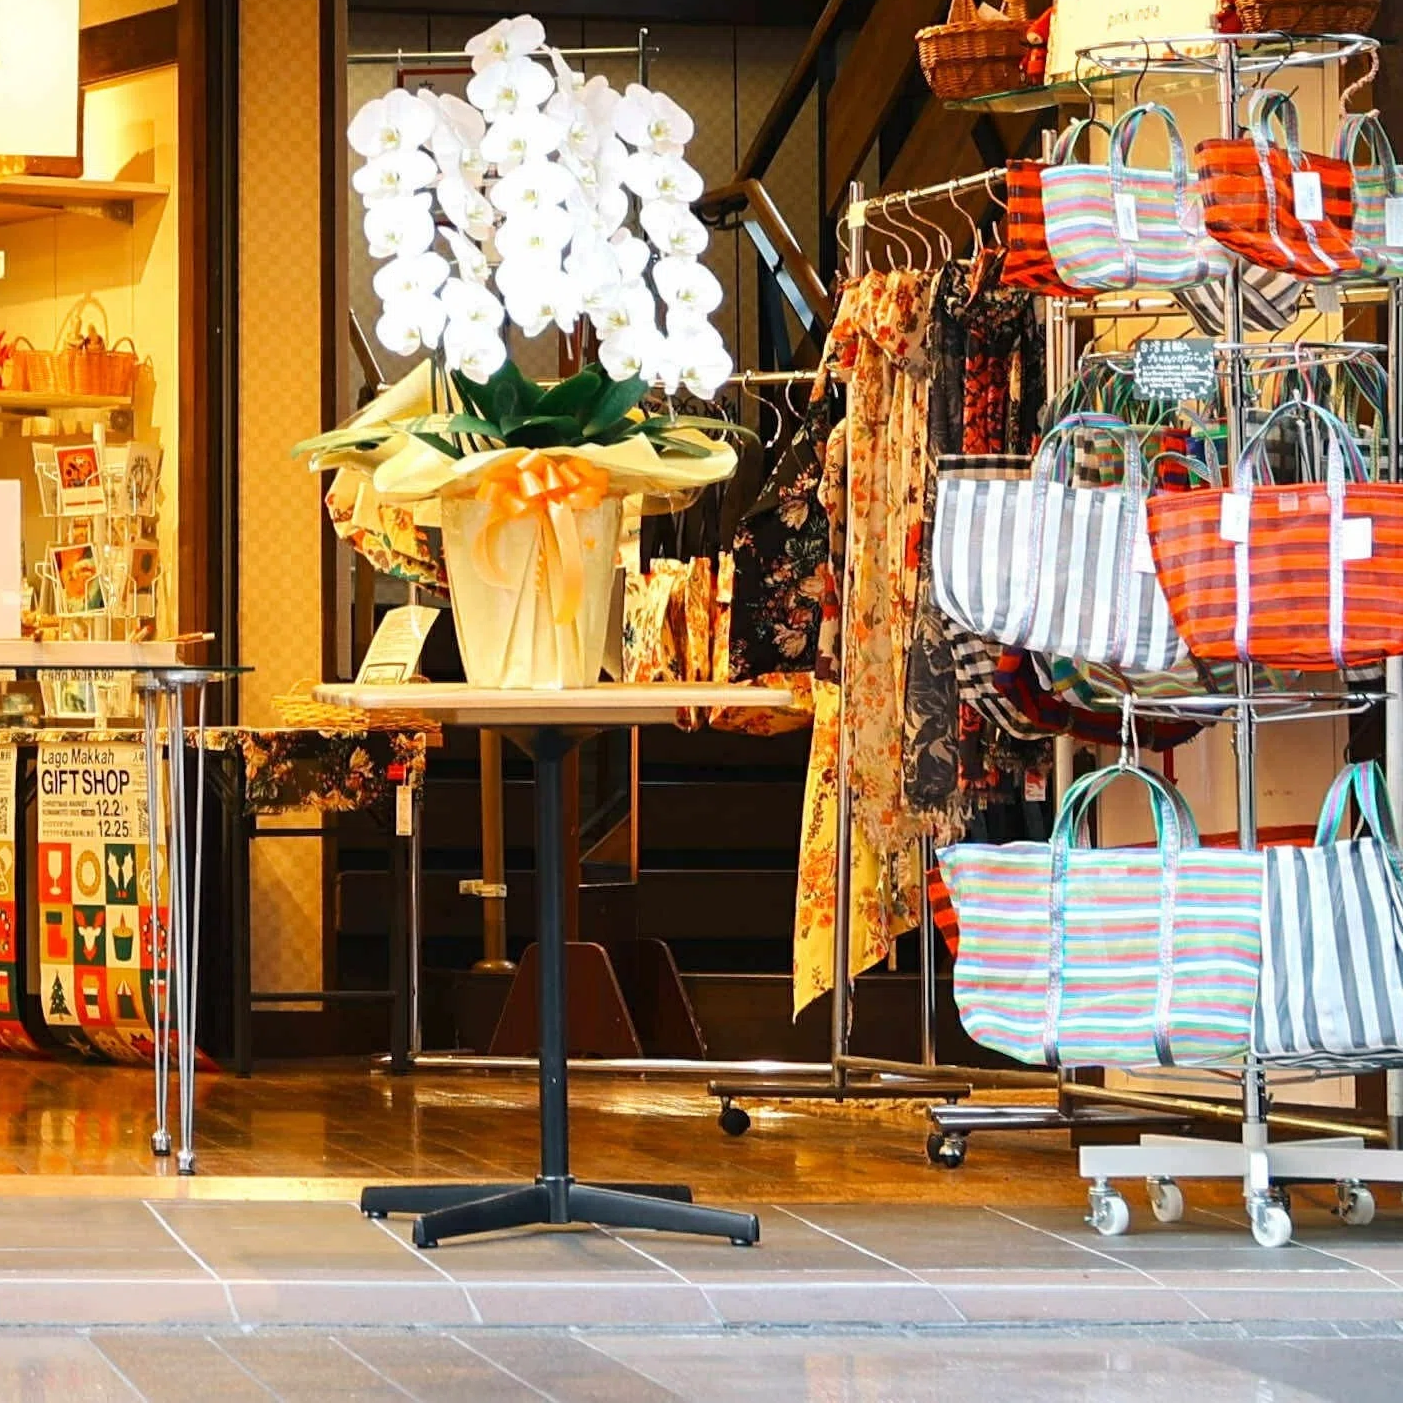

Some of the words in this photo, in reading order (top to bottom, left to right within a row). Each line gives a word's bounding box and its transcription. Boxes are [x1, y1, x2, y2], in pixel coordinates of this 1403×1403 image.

[41, 749, 68, 768] Lago
[71, 748, 114, 765] Makkah
[99, 820, 129, 837] 12.25
